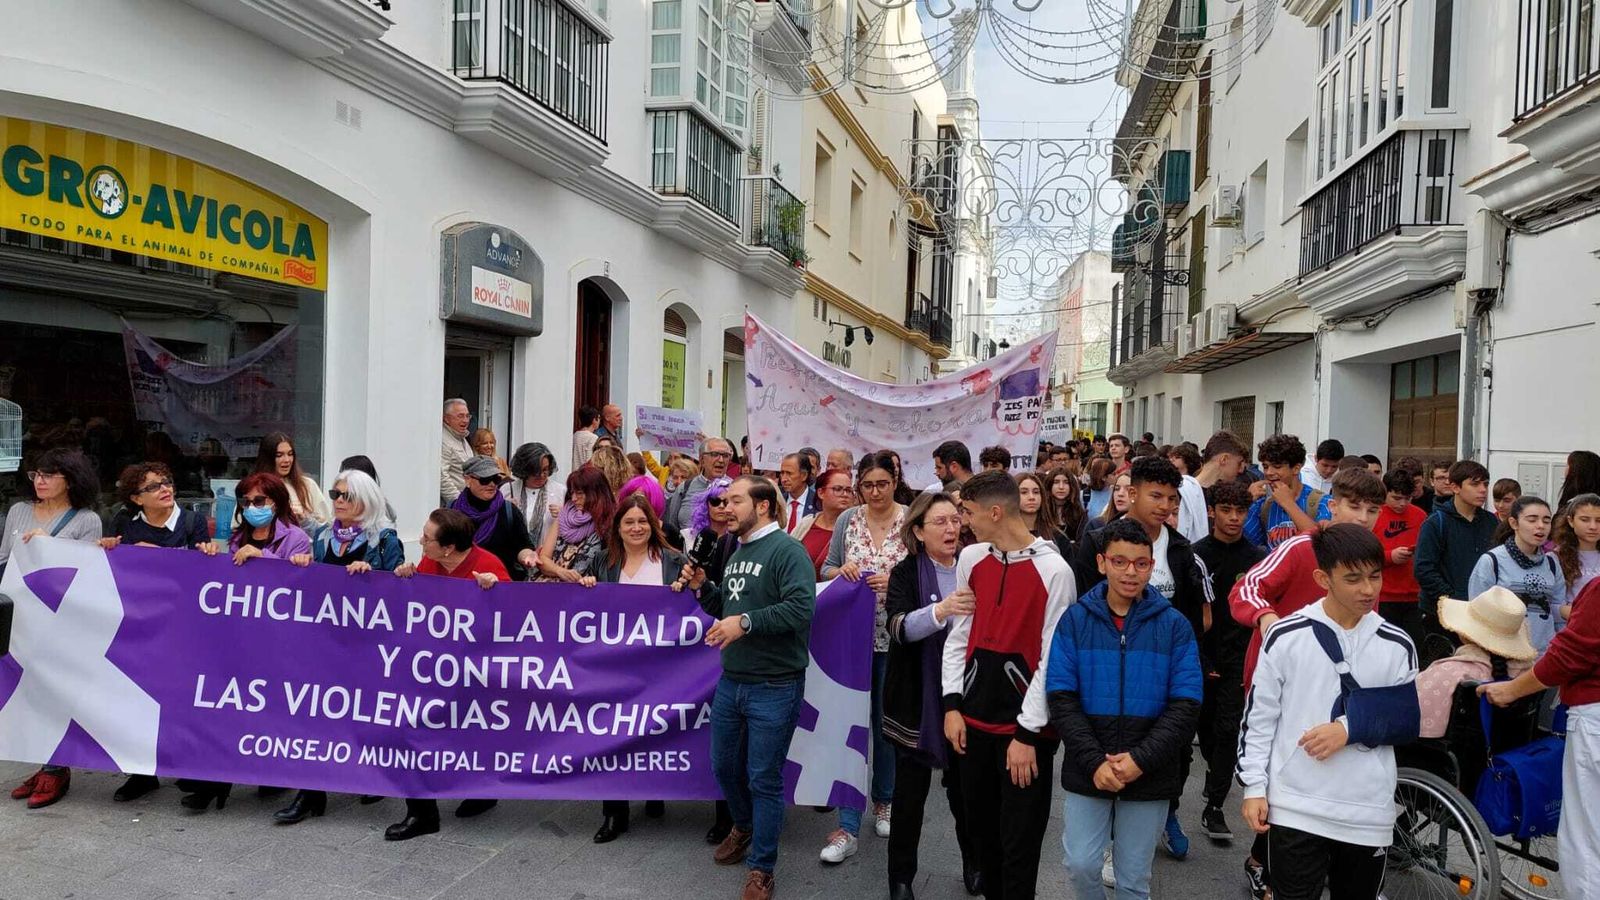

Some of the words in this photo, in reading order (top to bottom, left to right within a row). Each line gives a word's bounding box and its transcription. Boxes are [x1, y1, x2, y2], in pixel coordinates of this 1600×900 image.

[20, 213, 66, 231] TODO
[77, 225, 112, 241] PARA
[121, 234, 136, 246] EL
[143, 239, 192, 257] ANIMAL
[199, 250, 214, 262] DE
[487, 248, 520, 268] ADVANCE
[474, 286, 502, 307] ROYAL
[504, 295, 530, 314] CANIN
[724, 561, 763, 578] SILBON
[198, 581, 394, 631] CHICLANA
[405, 601, 477, 643] POR
[492, 610, 544, 643] LA
[557, 610, 704, 647] IGUALD
[377, 644, 402, 678] Y
[411, 650, 574, 690] CONTRA
[193, 674, 268, 713] LAS
[283, 681, 510, 732] VIOLENCIAS
[525, 701, 713, 737] MACHISTA
[238, 734, 352, 764] CONSEJO
[358, 745, 486, 771] MUNICIPAL
[493, 751, 525, 774] DE
[531, 753, 574, 775] LAS
[582, 750, 692, 772] MUJERES
